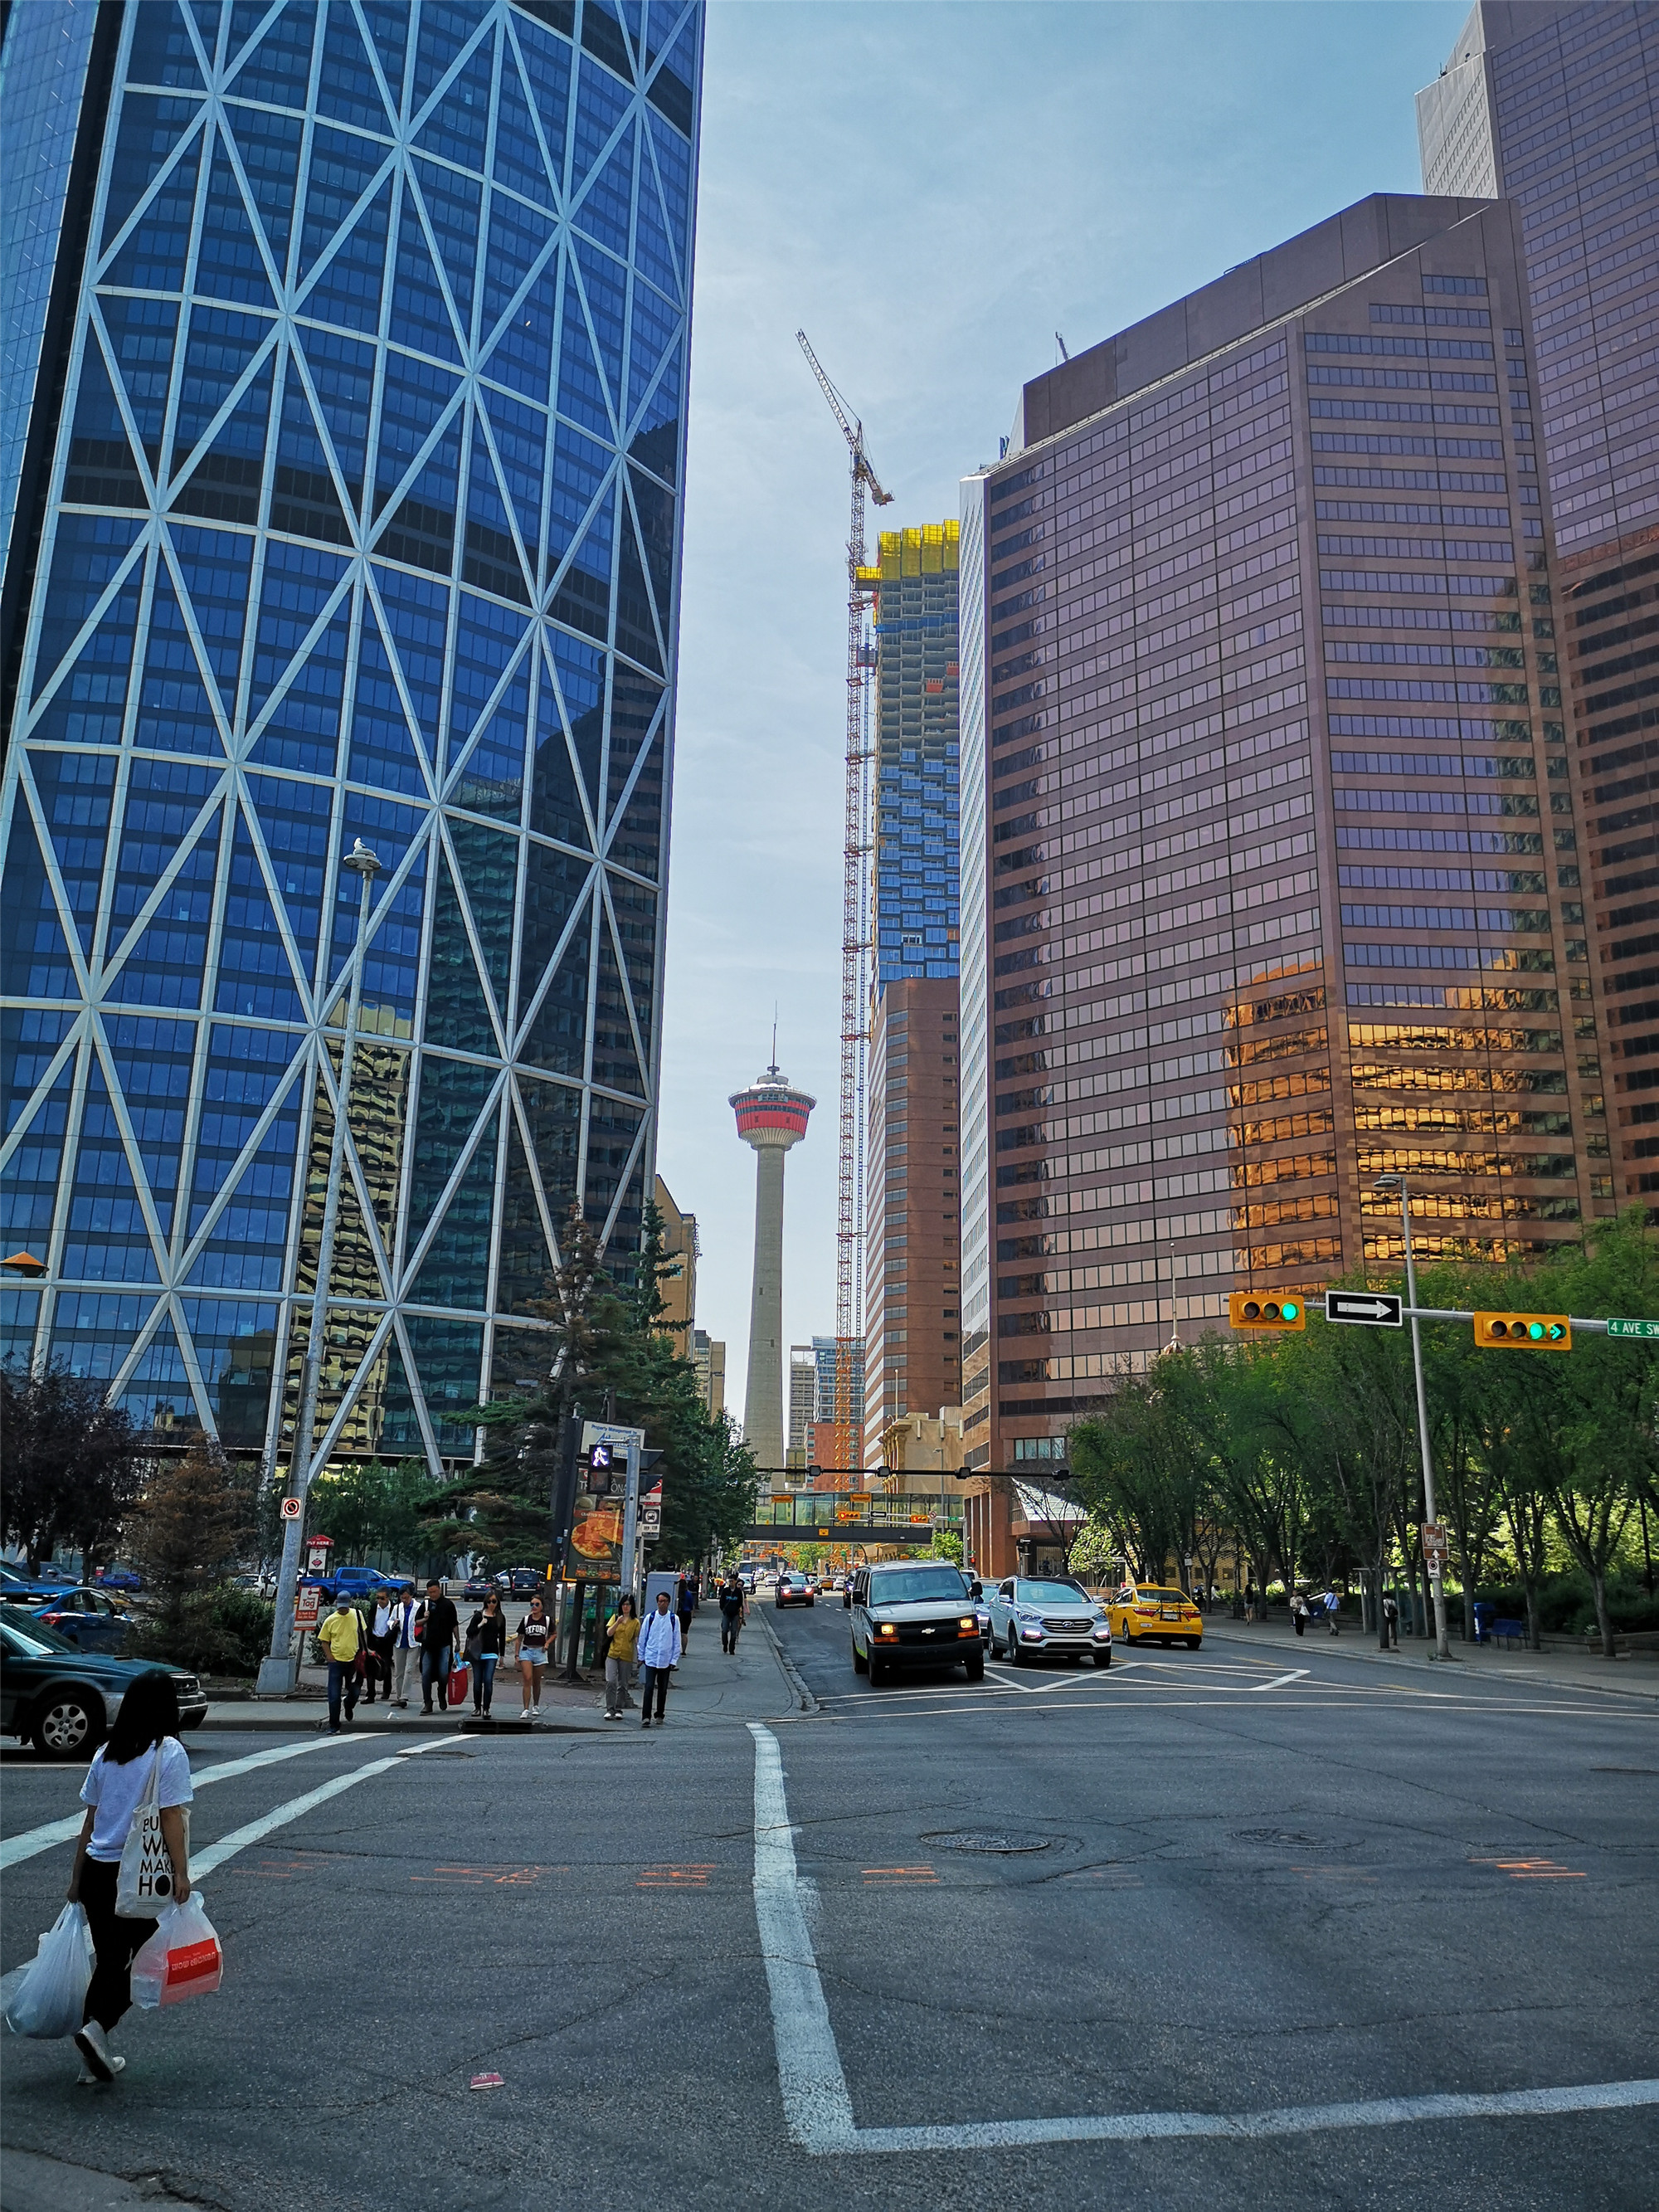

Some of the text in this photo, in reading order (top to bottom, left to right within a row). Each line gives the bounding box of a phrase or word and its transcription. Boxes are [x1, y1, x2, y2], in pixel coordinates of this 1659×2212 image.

[1610, 1321, 1618, 1333] 4
[1622, 1322, 1642, 1334] AVE
[302, 1598, 314, 1609] Tag
